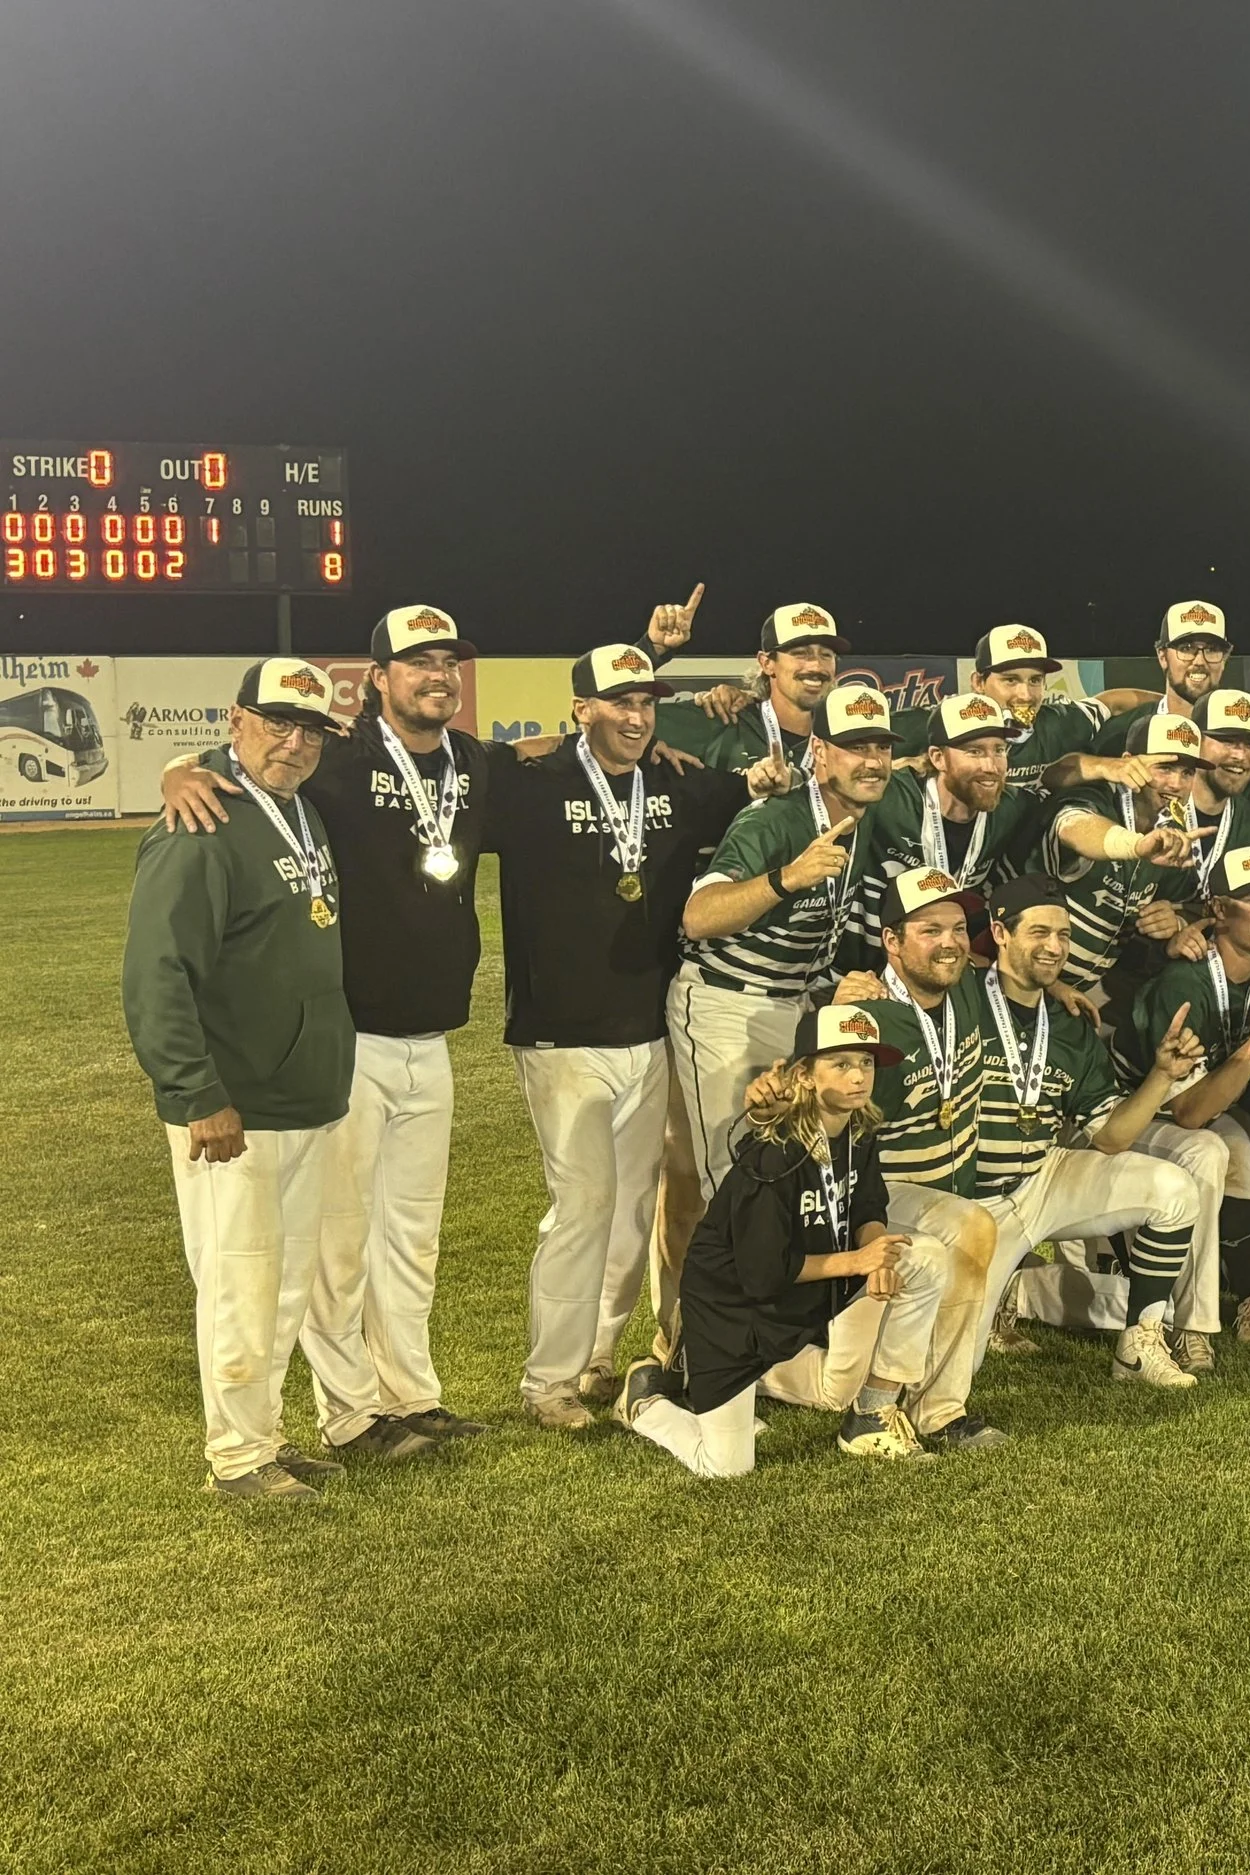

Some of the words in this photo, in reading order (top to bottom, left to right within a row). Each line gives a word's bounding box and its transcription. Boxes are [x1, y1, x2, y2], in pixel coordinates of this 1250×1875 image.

[13, 456, 88, 478] STRIKE
[90, 451, 111, 486] 0
[160, 459, 202, 481] OUT
[203, 453, 225, 488] 0
[285, 463, 319, 484] H/E
[10, 495, 16, 510] 1
[38, 496, 48, 510] 2
[70, 496, 79, 511] 3
[107, 497, 117, 511] 4
[140, 497, 150, 512] 5
[168, 498, 178, 513] 6
[205, 498, 215, 514] 7
[232, 499, 242, 514] 8
[260, 500, 270, 515] 9
[298, 500, 343, 517] RUNS
[5, 514, 23, 542] 0
[34, 515, 52, 542] 0
[66, 515, 84, 542] 0
[103, 516, 123, 544] 0
[136, 516, 154, 544] 0
[165, 516, 183, 544] 0
[210, 518, 219, 543] 1
[333, 520, 342, 546] 1
[7, 549, 24, 577] 3
[36, 549, 53, 577] 0
[69, 549, 86, 577] 3
[106, 550, 124, 577] 0
[137, 550, 155, 578] 0
[166, 550, 184, 578] 2
[324, 553, 343, 580] 8
[0, 656, 70, 687] lheim
[148, 726, 221, 737] consulting
[19, 797, 58, 808] driving
[61, 797, 72, 806] to
